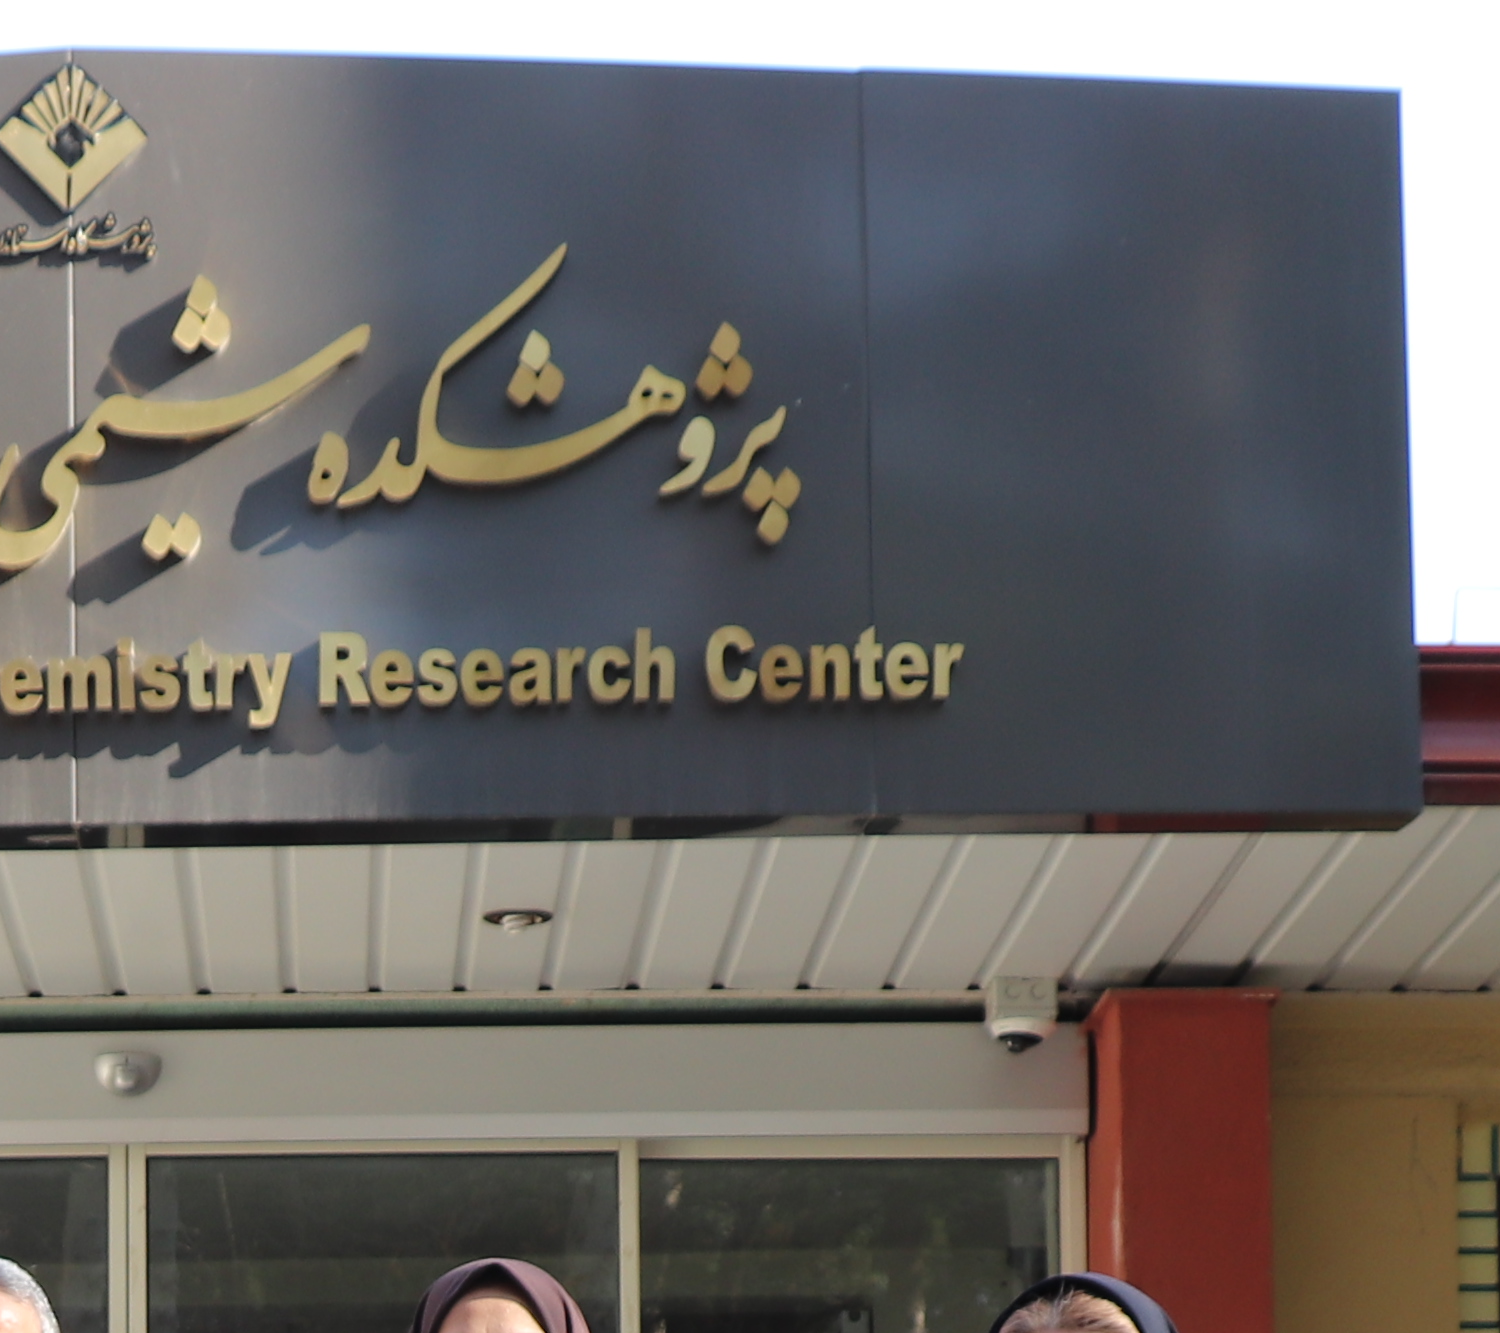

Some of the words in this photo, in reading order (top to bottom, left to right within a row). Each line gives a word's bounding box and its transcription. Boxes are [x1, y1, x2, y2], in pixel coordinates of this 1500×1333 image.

[307, 243, 800, 546] پژوهشکده
[317, 627, 676, 709] Research
[704, 625, 963, 705] Center
